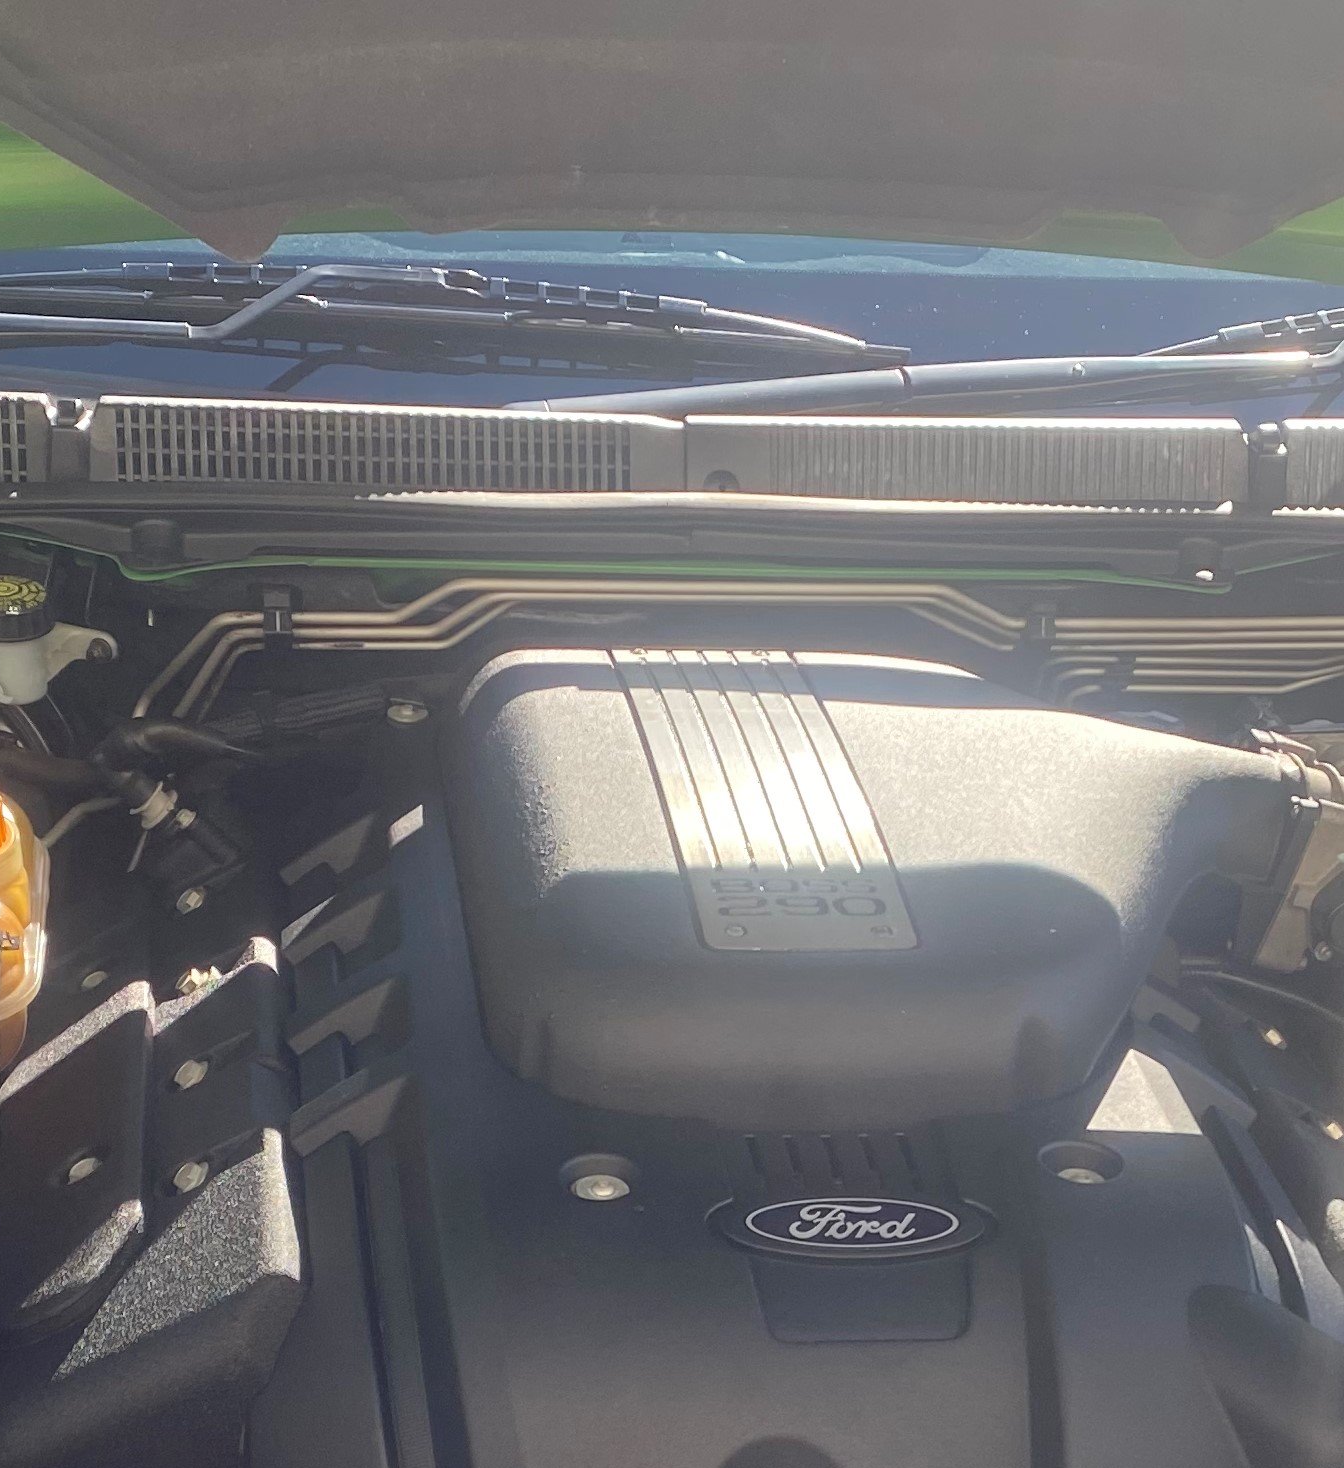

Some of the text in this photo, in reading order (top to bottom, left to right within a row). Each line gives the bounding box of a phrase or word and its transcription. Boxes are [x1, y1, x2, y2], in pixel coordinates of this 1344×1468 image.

[709, 877, 878, 894] BOSS
[716, 895, 886, 918] 290
[788, 1201, 916, 1242] Ford
